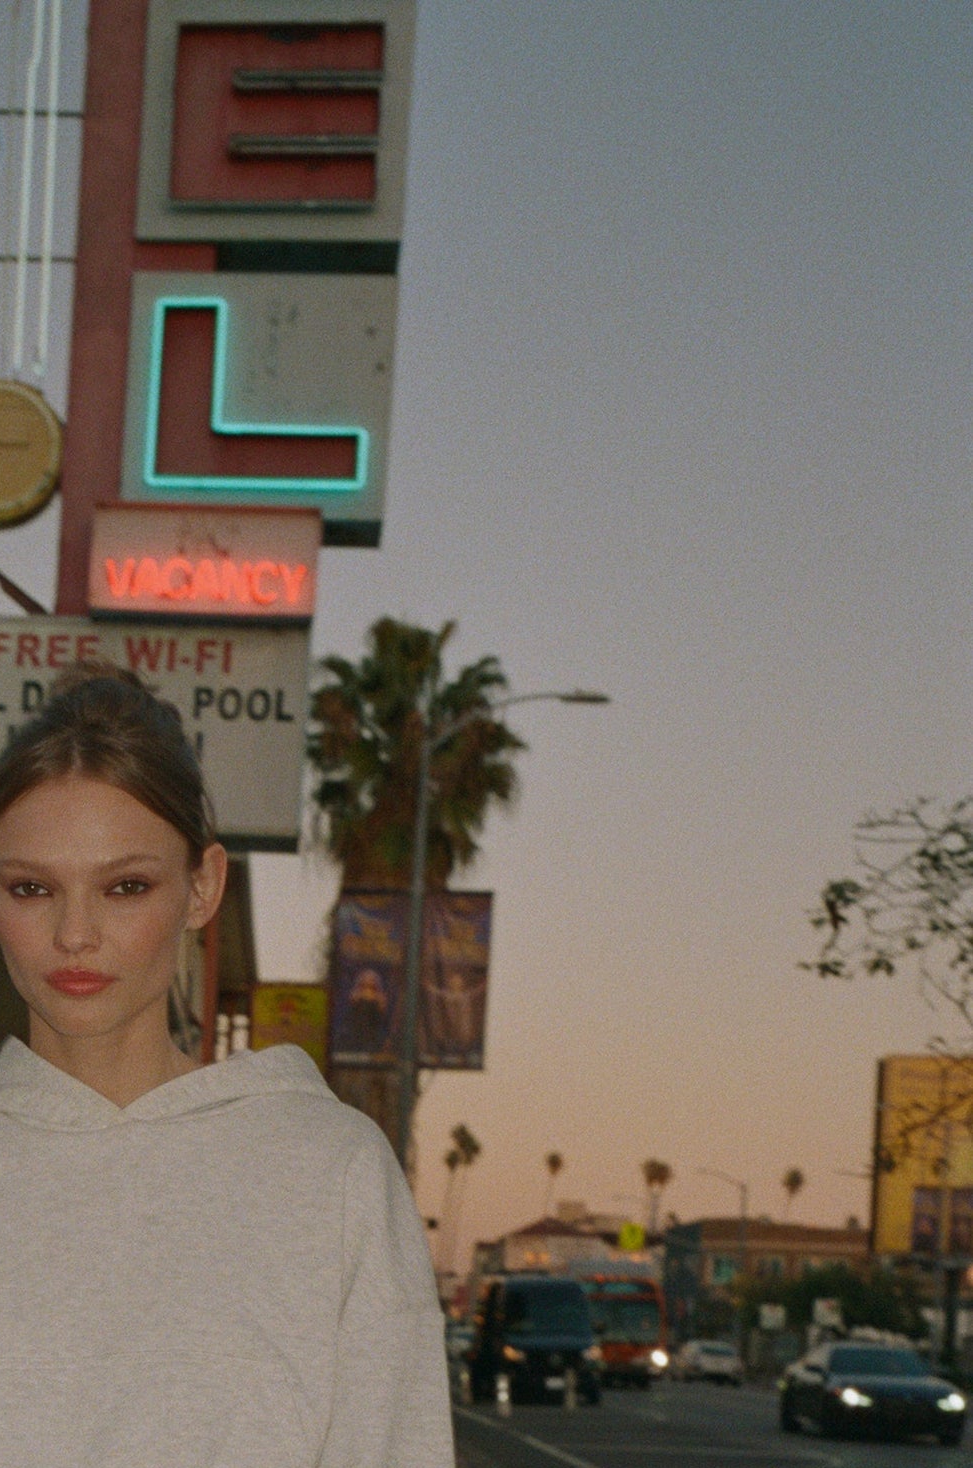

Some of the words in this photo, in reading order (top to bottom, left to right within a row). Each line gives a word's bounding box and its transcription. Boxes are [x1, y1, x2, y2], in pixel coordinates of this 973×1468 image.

[106, 556, 307, 605] VACANCY
[125, 636, 233, 674] WI-FI
[193, 686, 294, 722] POOL
